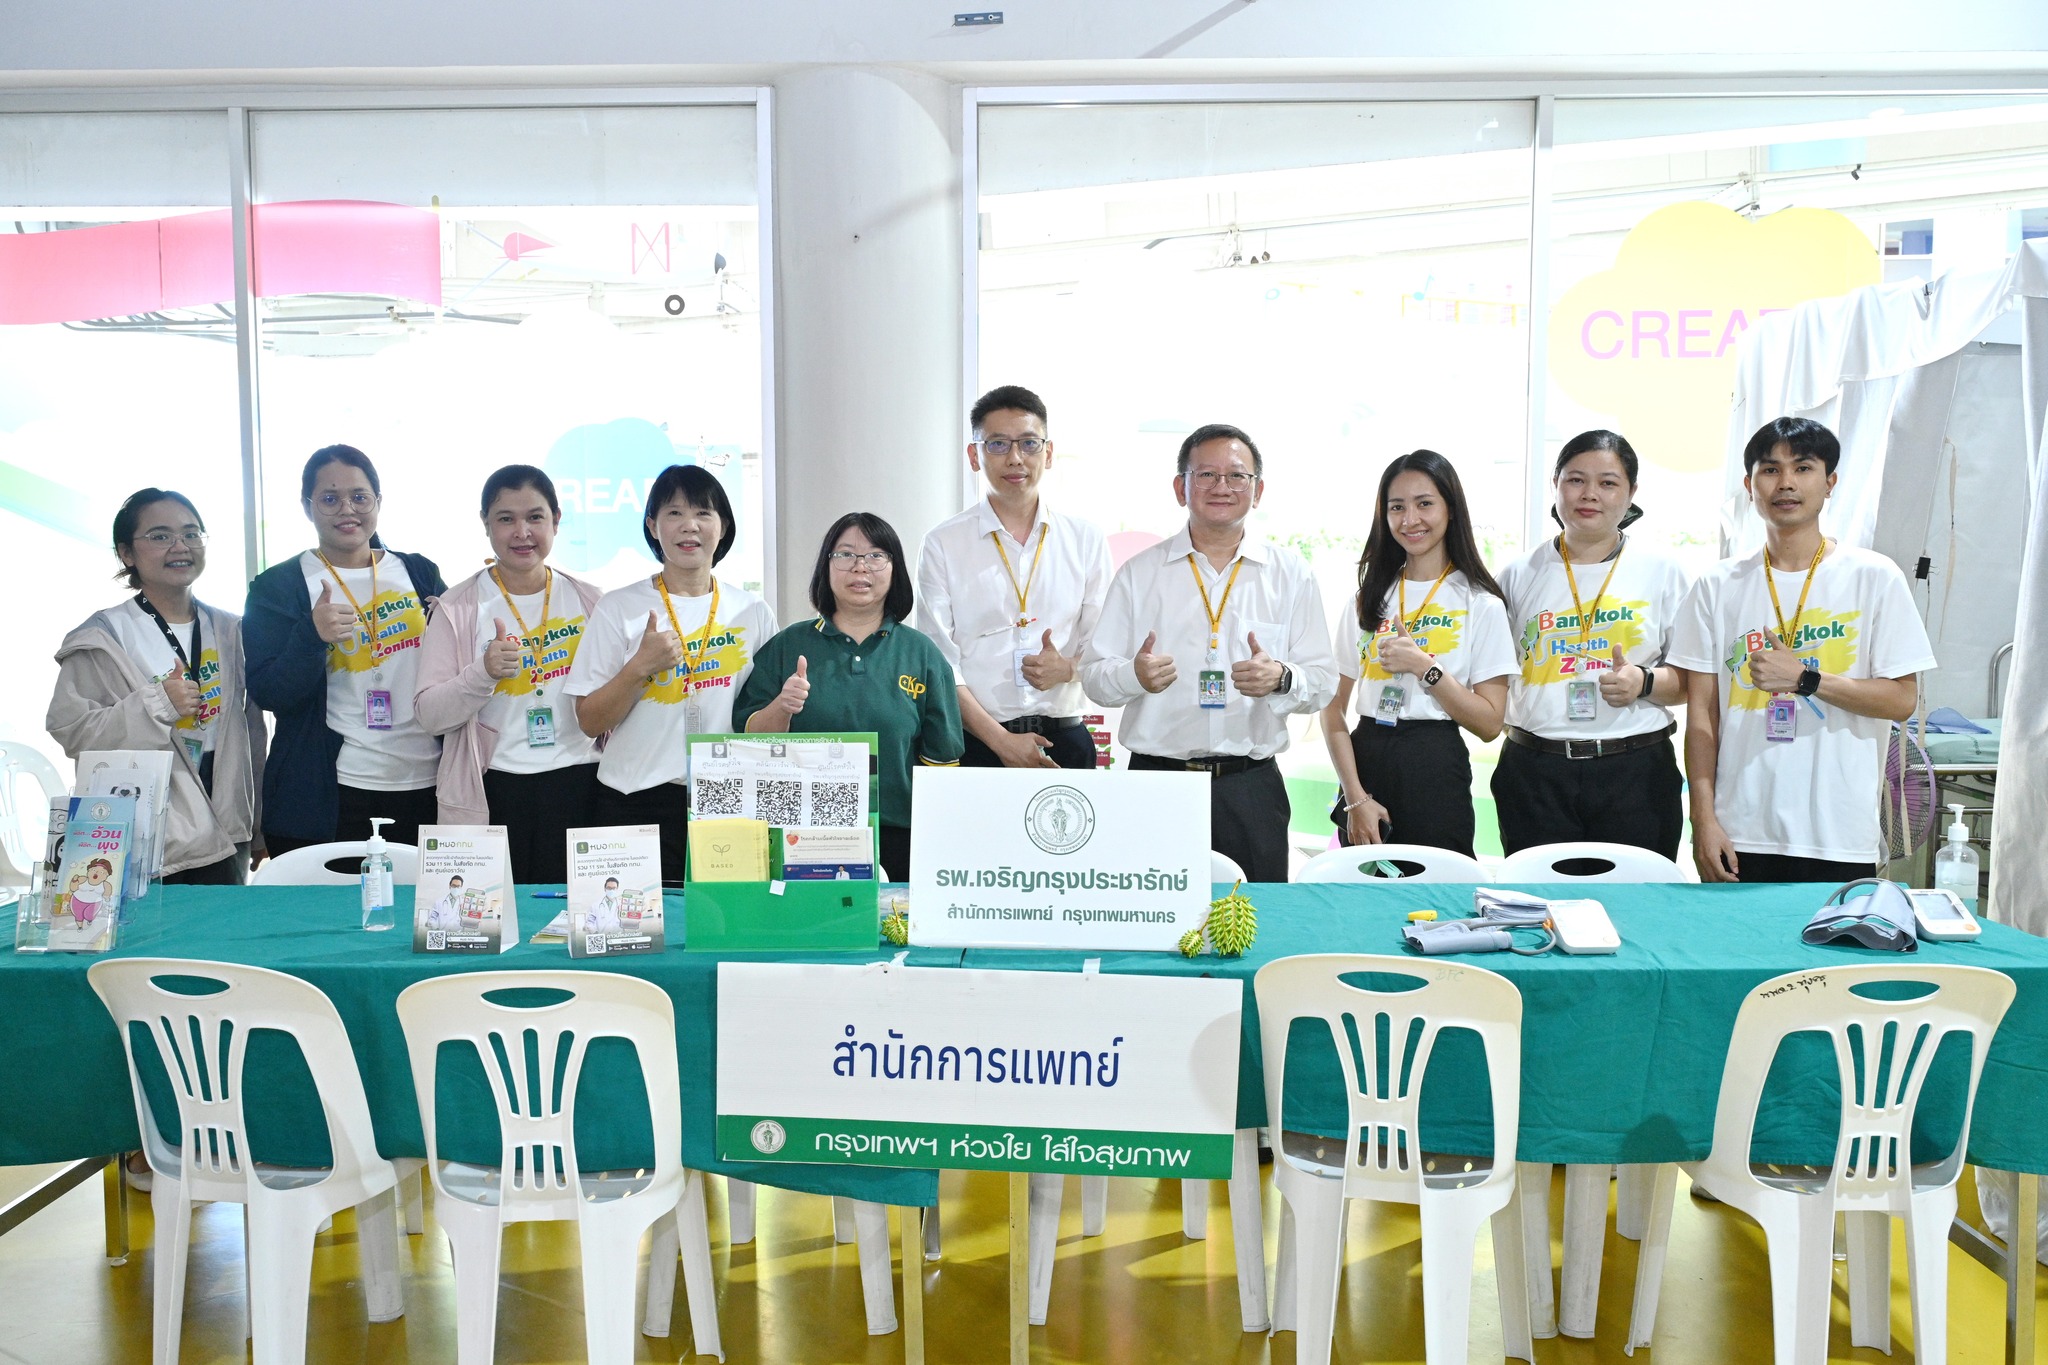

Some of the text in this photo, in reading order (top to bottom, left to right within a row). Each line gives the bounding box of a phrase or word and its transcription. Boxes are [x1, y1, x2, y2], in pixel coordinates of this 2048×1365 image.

[91, 825, 123, 840] อ้วน
[97, 841, 120, 855] พุง
[439, 840, 456, 848] หมอ
[589, 843, 608, 851] หมอ
[935, 866, 1188, 895] รพ.เจริญกรุงประชารักษ์
[947, 903, 1176, 926] สำนักการแพทย์ กรุงเทพมหานคร
[831, 1023, 1124, 1089] สำนักการแพทย์
[814, 1130, 1192, 1175] กรุงเทพฯ ห่วงใย ใส่ใจสุขภาพ
